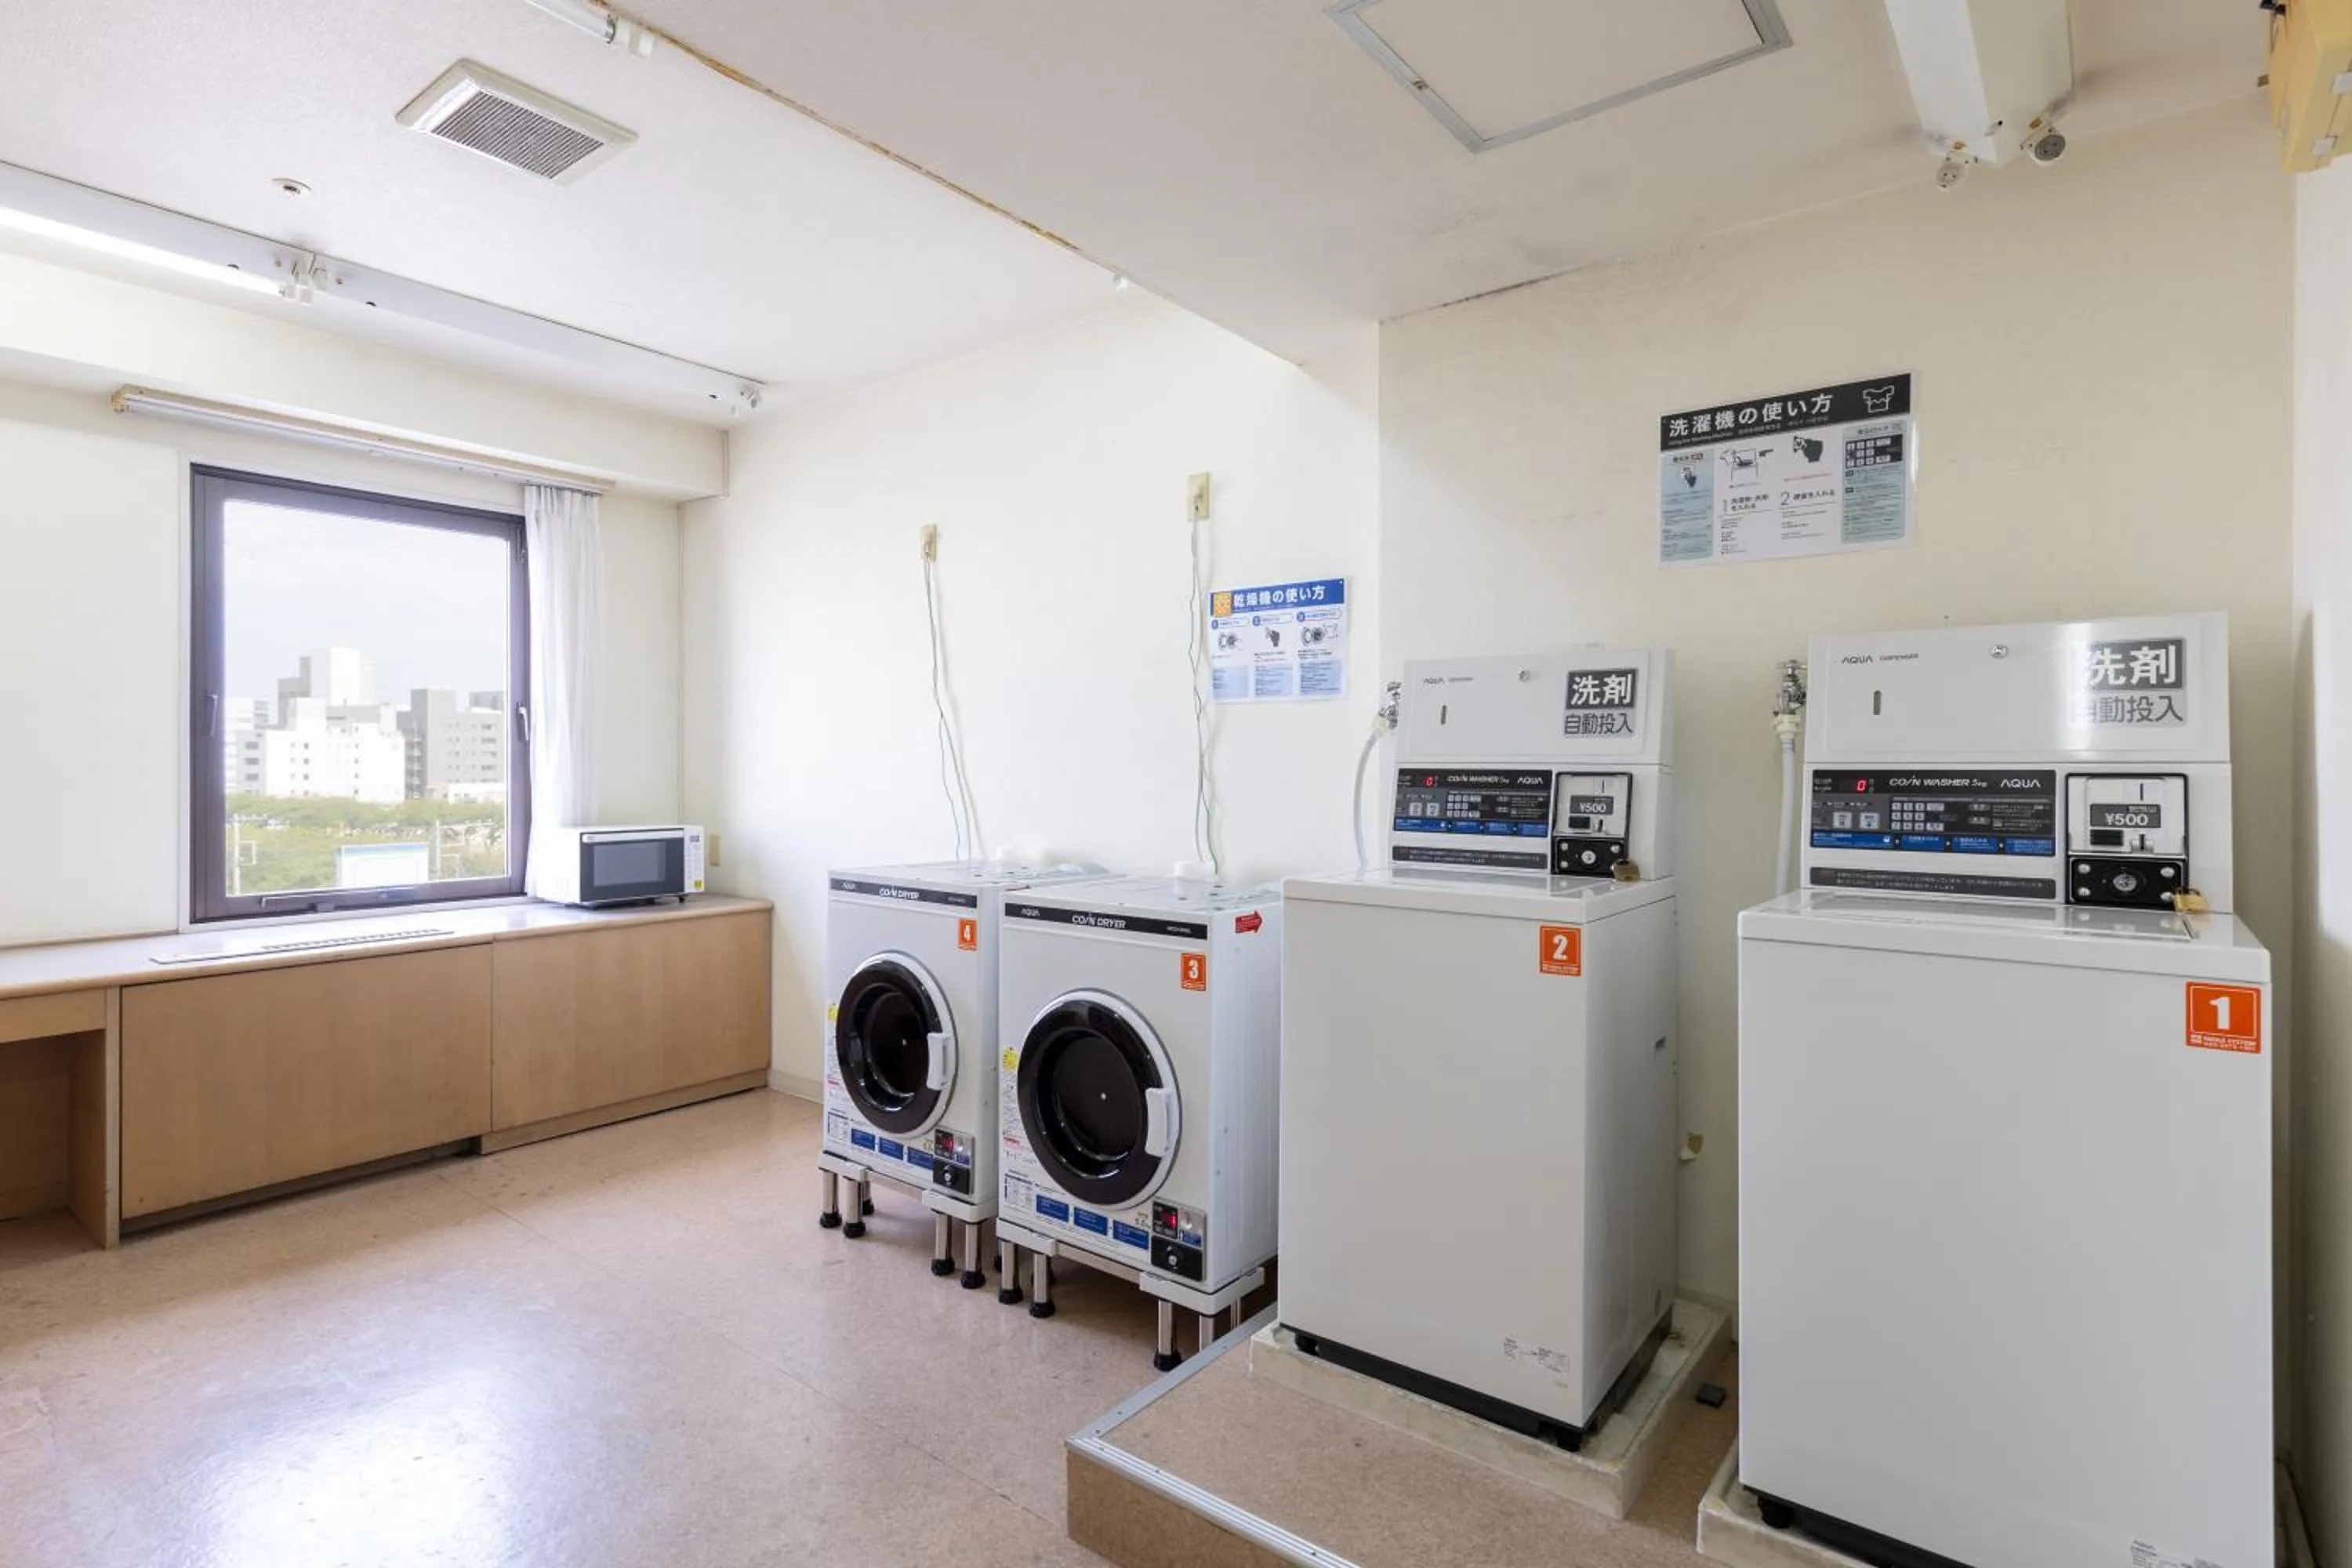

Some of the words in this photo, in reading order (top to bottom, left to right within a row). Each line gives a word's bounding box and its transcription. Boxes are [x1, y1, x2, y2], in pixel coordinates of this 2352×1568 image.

[1668, 393, 1834, 437] 洗濯機の使い方
[1233, 586, 1326, 608] 乾燥機の使い方
[1841, 655, 1874, 664] AQUA
[1571, 674, 1632, 704] 洗剤
[1564, 712, 1634, 735] 自動投入
[1856, 779, 1867, 792] 0
[2000, 779, 2042, 788] AQUA
[1580, 803, 1606, 813] ¥500
[2103, 812, 2149, 826] ¥500
[964, 924, 971, 942] 4
[1097, 918, 1127, 929] DRYER
[1553, 934, 1568, 960] 2
[1189, 959, 1199, 979] 3
[2209, 996, 2230, 1029] 1
